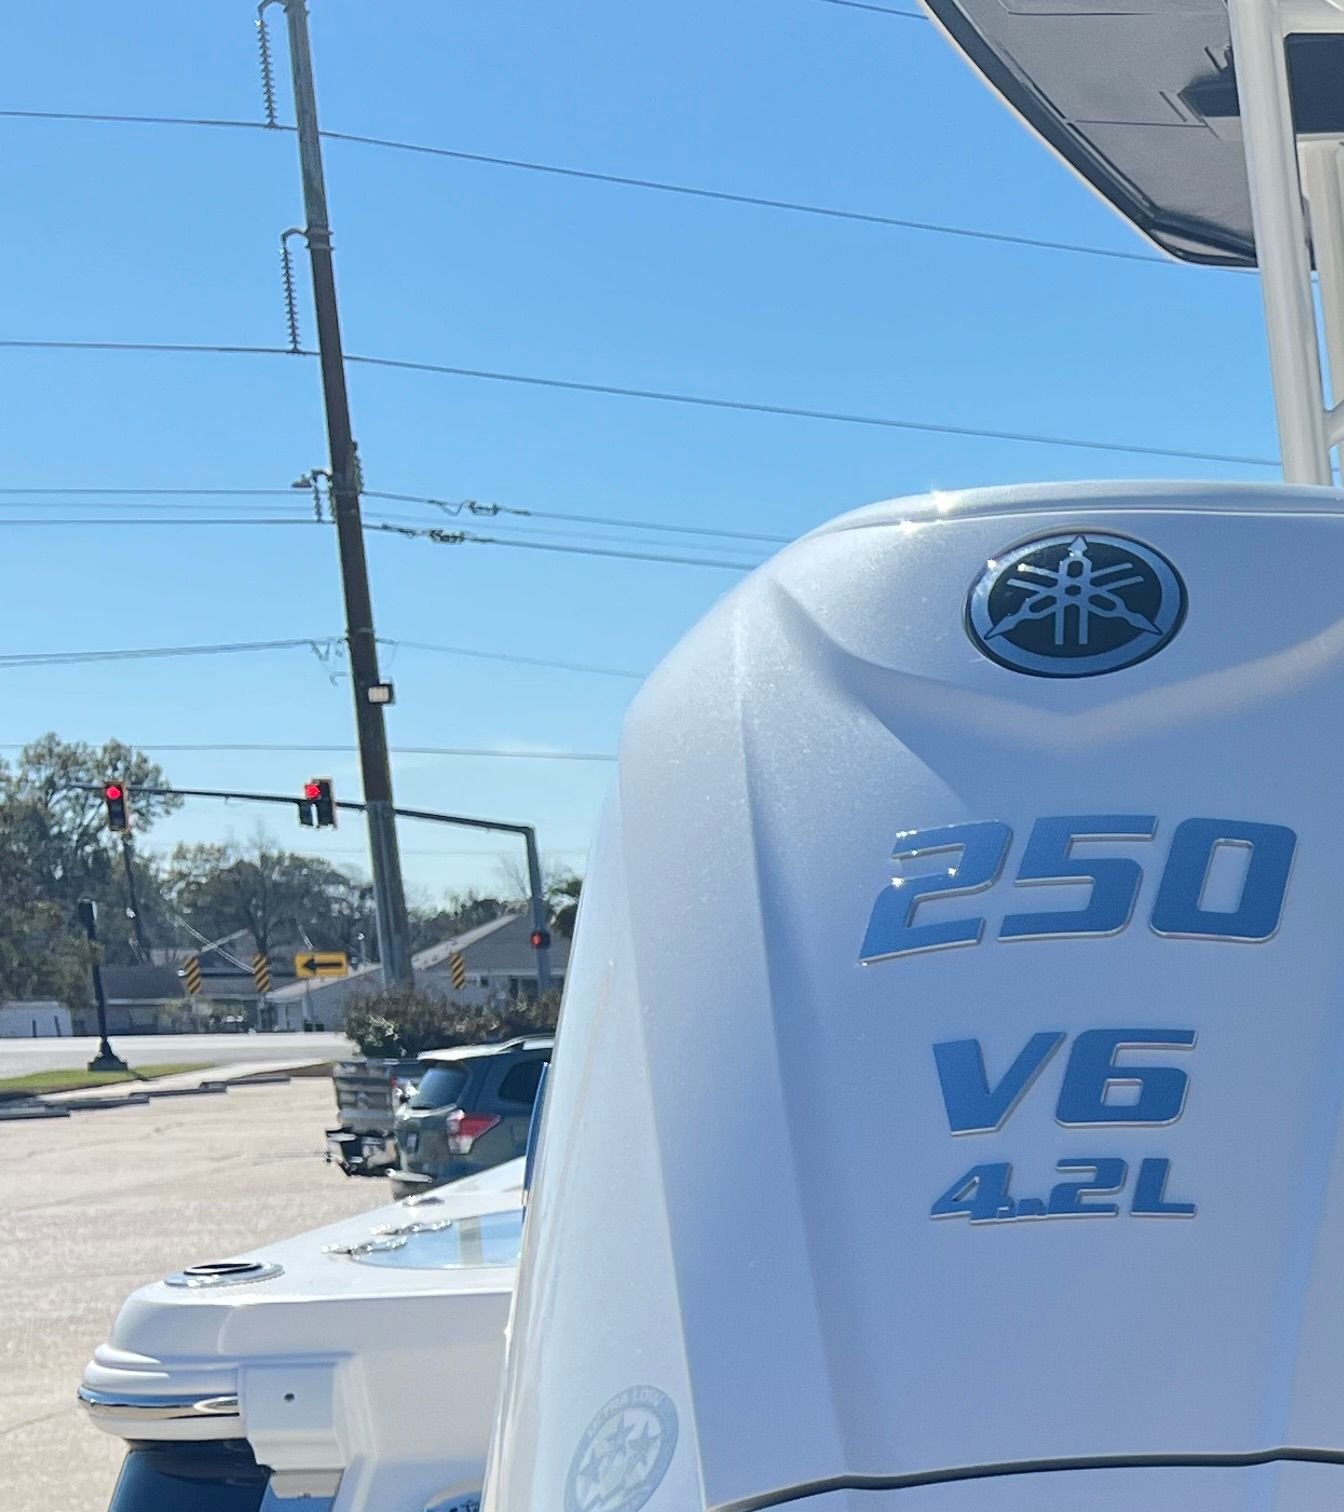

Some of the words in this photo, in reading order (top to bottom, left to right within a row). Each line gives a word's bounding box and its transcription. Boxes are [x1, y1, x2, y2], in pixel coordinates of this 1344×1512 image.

[858, 814, 1298, 967] 250
[931, 1028, 1199, 1138] V6
[929, 1156, 1199, 1226] 4.2L
